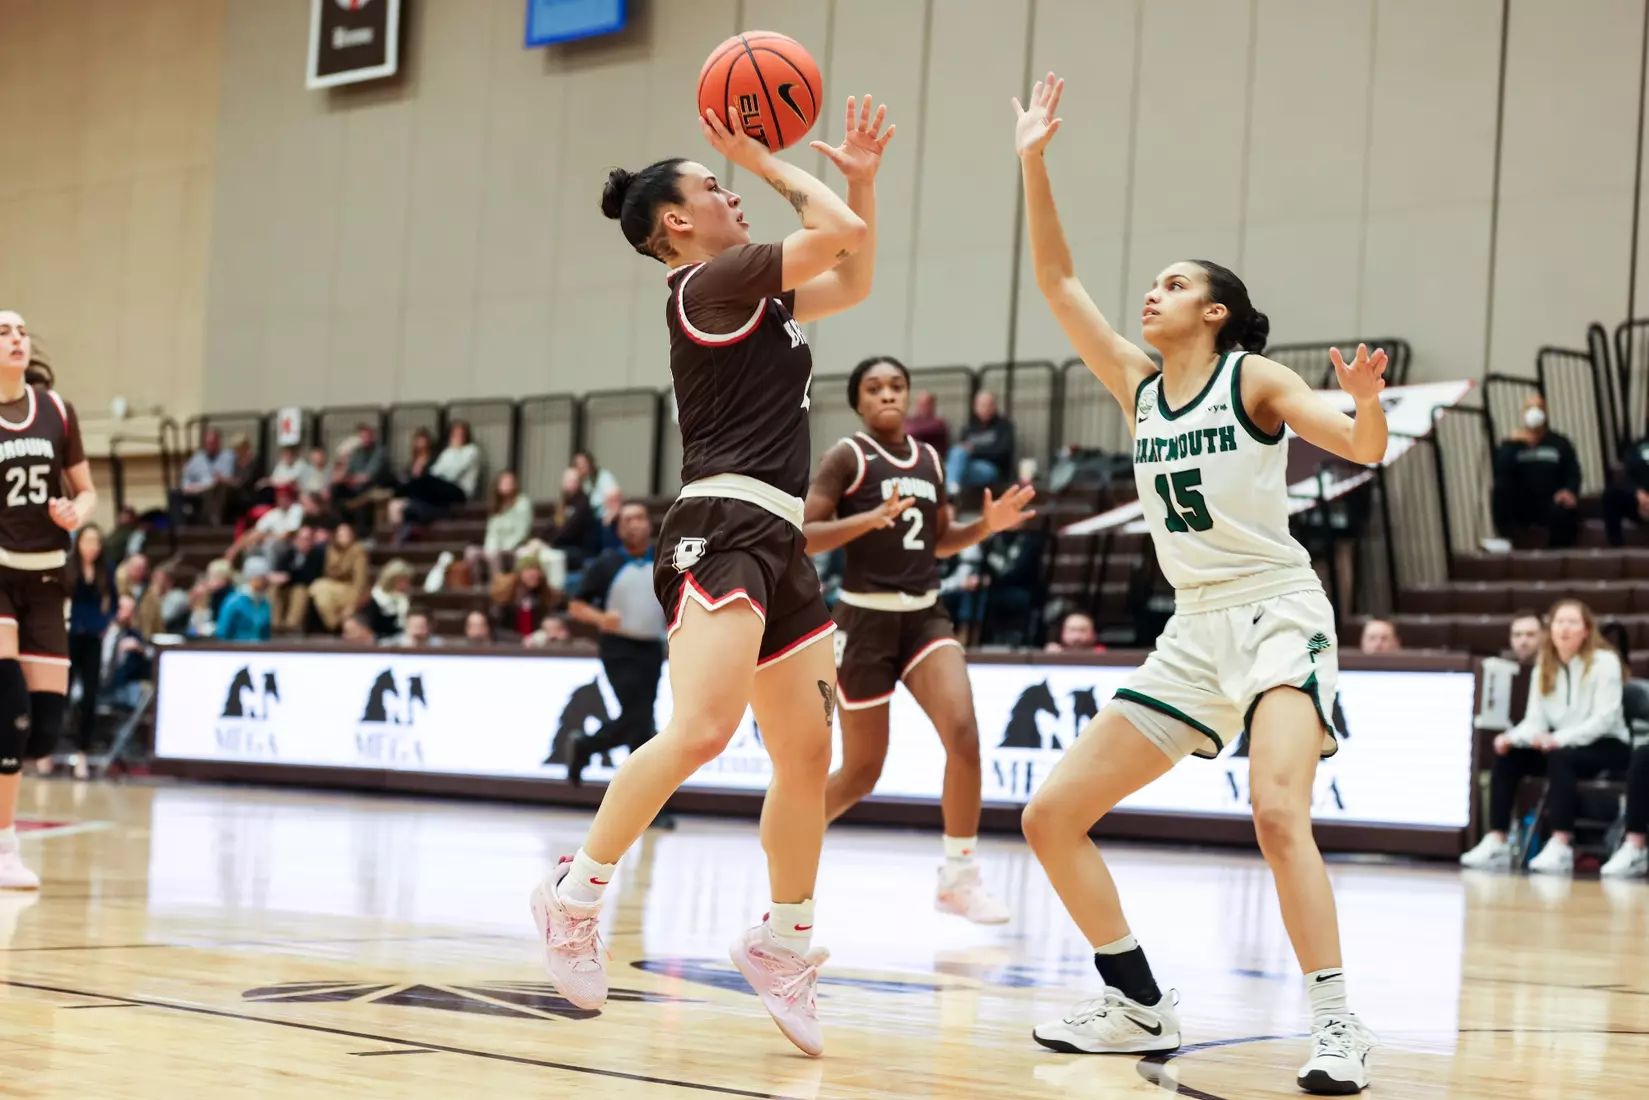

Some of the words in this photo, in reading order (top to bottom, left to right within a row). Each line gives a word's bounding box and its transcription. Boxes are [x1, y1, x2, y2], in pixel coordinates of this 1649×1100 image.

[1135, 425, 1237, 464] DATMOUTH
[5, 465, 50, 507] 25
[1155, 468, 1214, 533] 15
[902, 507, 925, 550] 2
